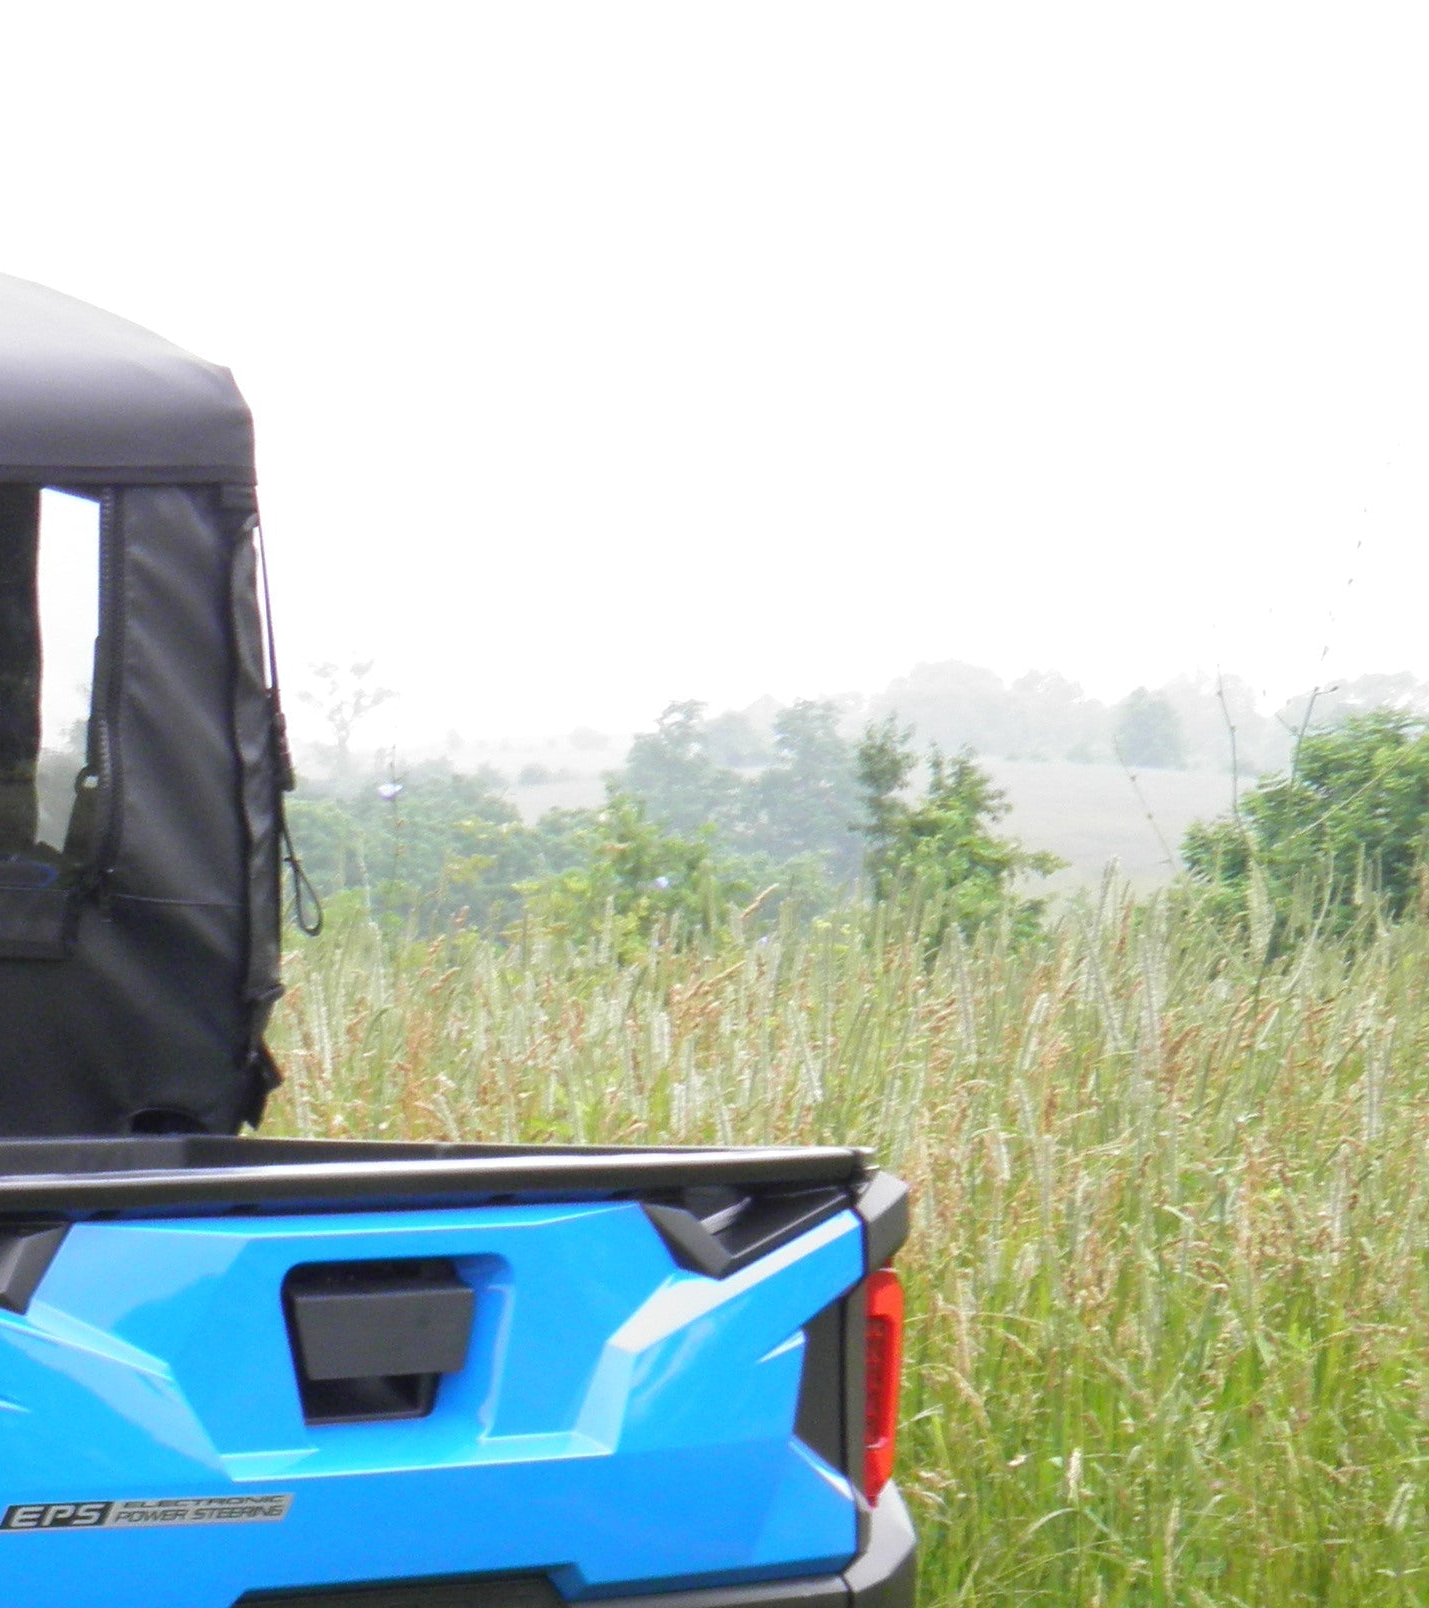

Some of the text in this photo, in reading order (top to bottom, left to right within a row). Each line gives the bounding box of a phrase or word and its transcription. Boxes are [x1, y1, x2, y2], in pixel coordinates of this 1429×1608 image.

[123, 1494, 289, 1508] ELECTRONIC
[9, 1503, 104, 1528] EPS
[114, 1504, 284, 1523] POWER STEERING
